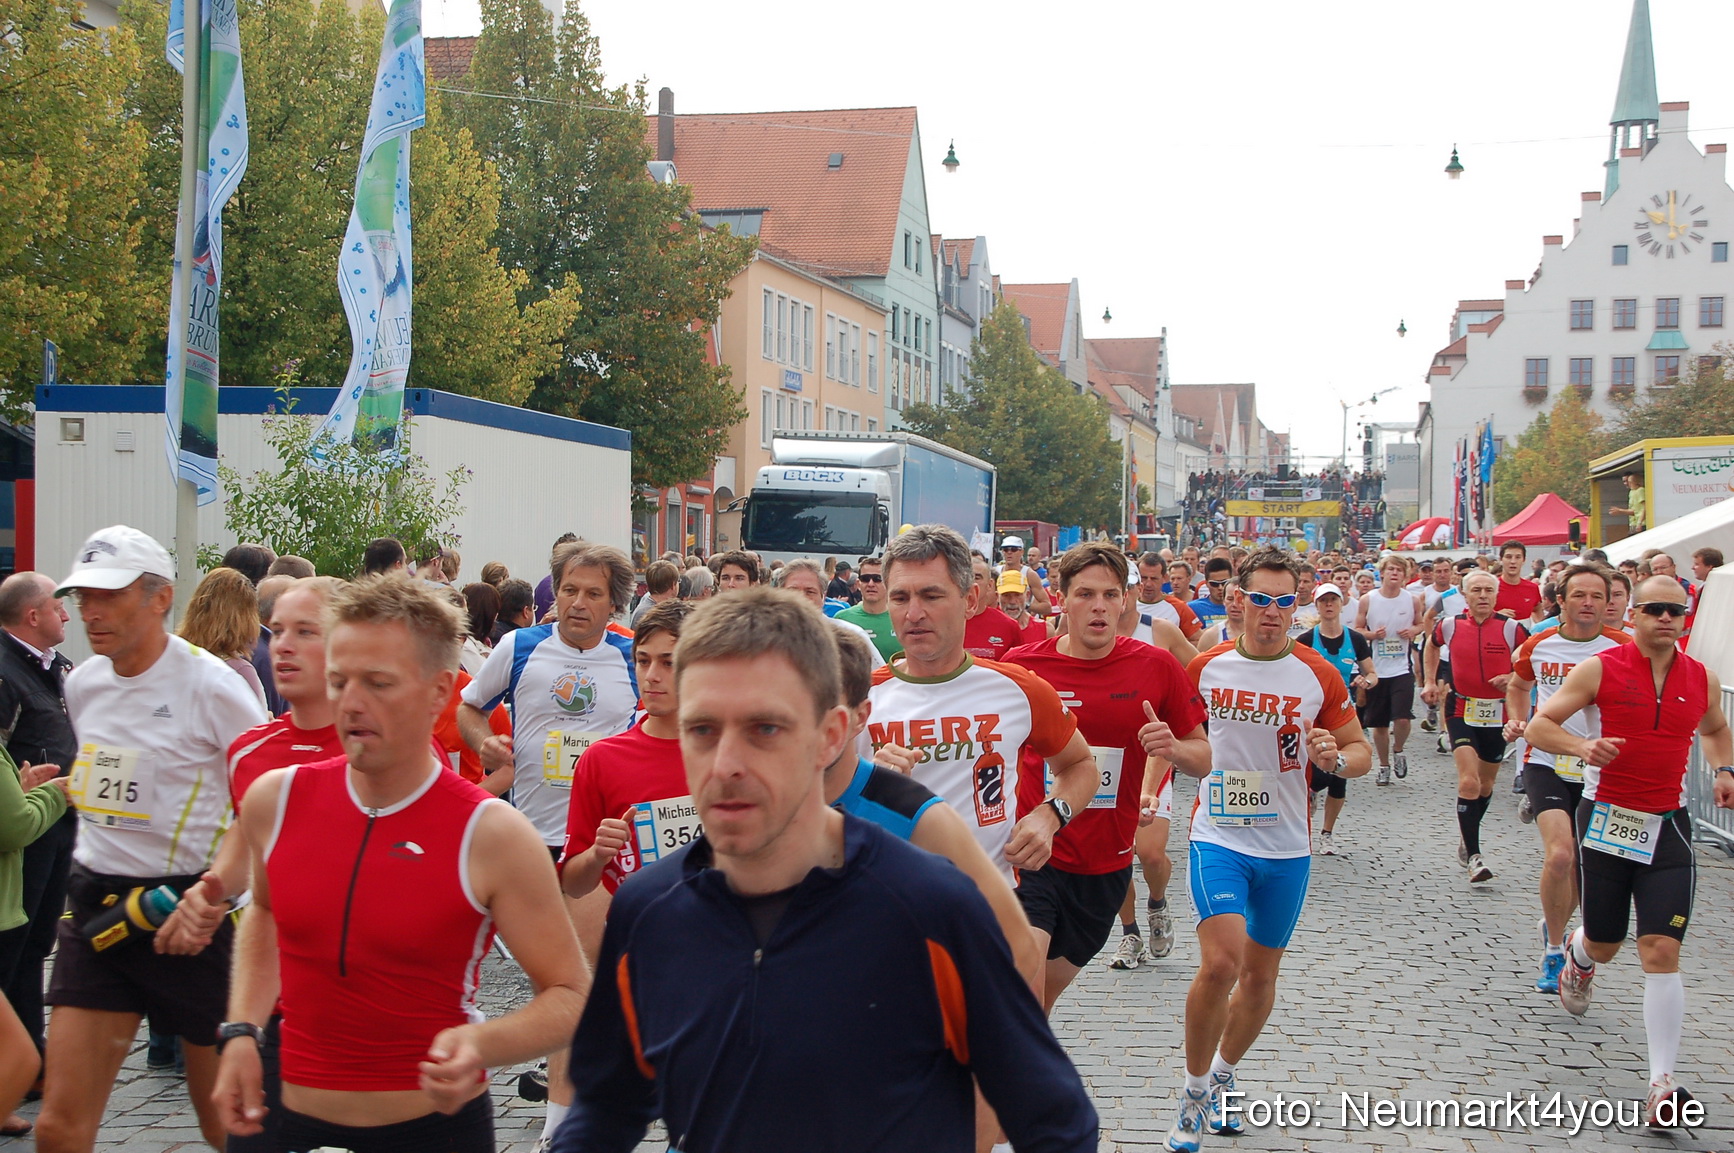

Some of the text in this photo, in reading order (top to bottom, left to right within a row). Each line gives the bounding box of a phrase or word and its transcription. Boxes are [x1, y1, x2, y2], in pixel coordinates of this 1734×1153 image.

[784, 469, 844, 483] BOCK
[1262, 503, 1301, 514] START
[1211, 687, 1302, 718] MERZ
[1479, 709, 1496, 718] 321
[868, 713, 1003, 750] MERZ
[563, 735, 590, 748] Mario
[1101, 770, 1112, 787] 3
[1226, 775, 1246, 788] Jörg
[98, 777, 138, 803] 215
[1228, 791, 1270, 806] 2860
[657, 804, 698, 820] Michae
[1612, 808, 1644, 826] Karsten
[663, 823, 704, 848] 354
[1608, 822, 1649, 844] 2899
